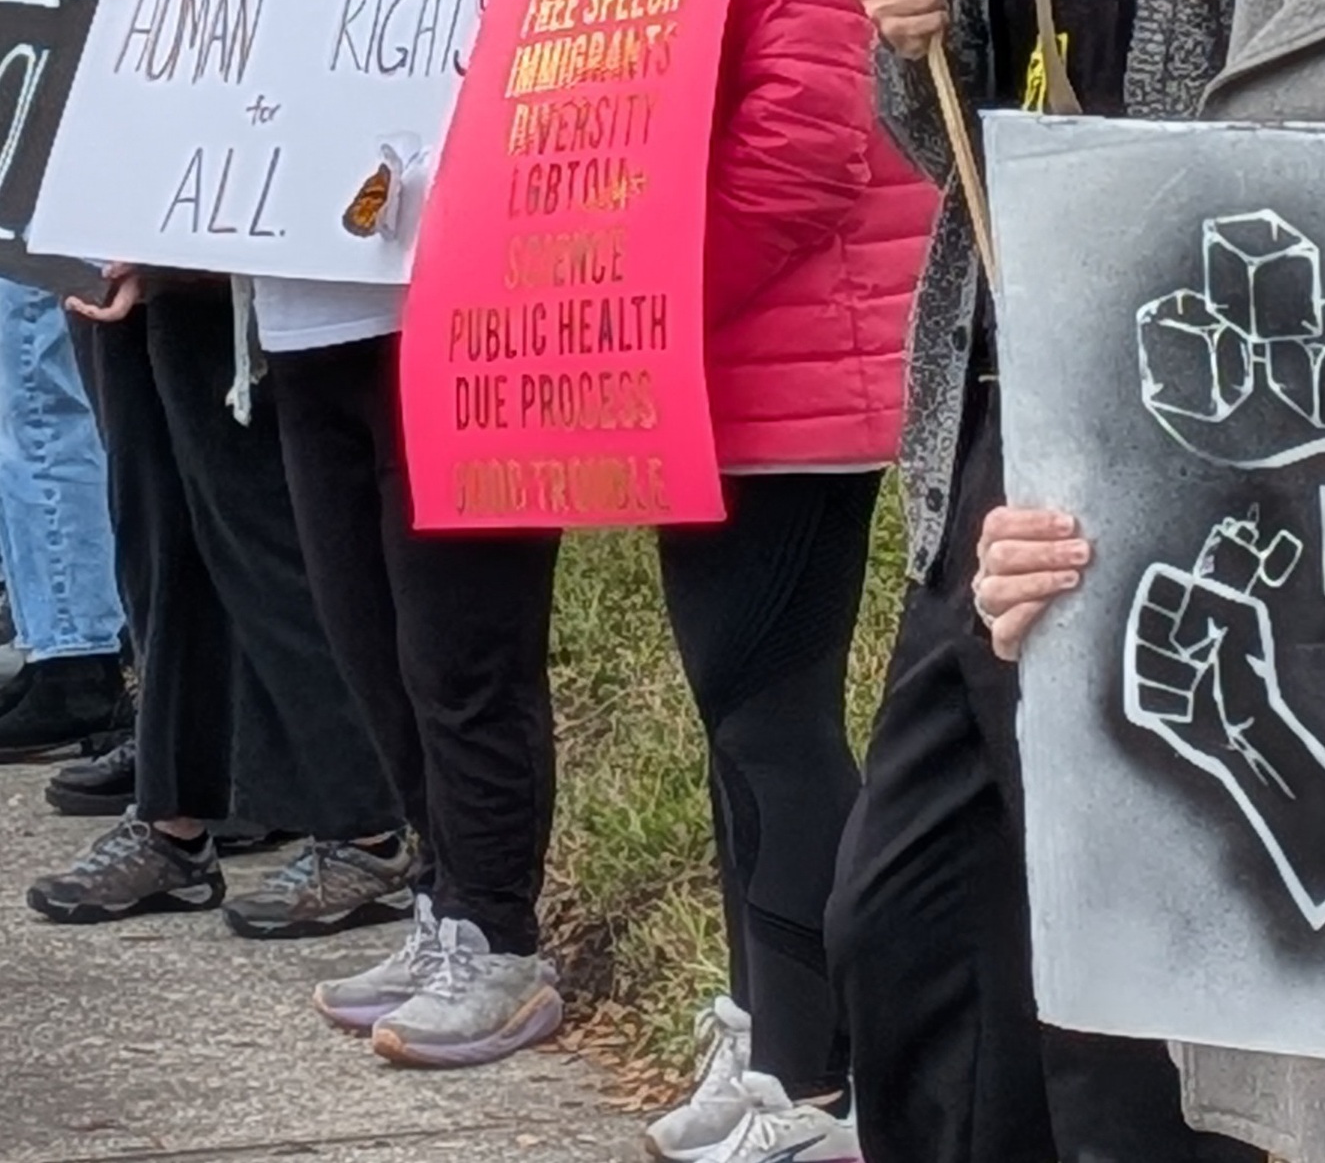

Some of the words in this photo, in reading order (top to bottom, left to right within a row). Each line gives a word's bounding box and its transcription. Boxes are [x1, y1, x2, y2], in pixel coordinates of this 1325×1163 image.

[505, 21, 679, 99] IMMIGRANTS
[245, 95, 282, 125] for
[507, 93, 654, 157] DIVERSITY
[448, 301, 547, 363] PUBLIC
[557, 293, 668, 355] HEALTH
[455, 373, 509, 431] DUE
[520, 369, 660, 431] PROCESS
